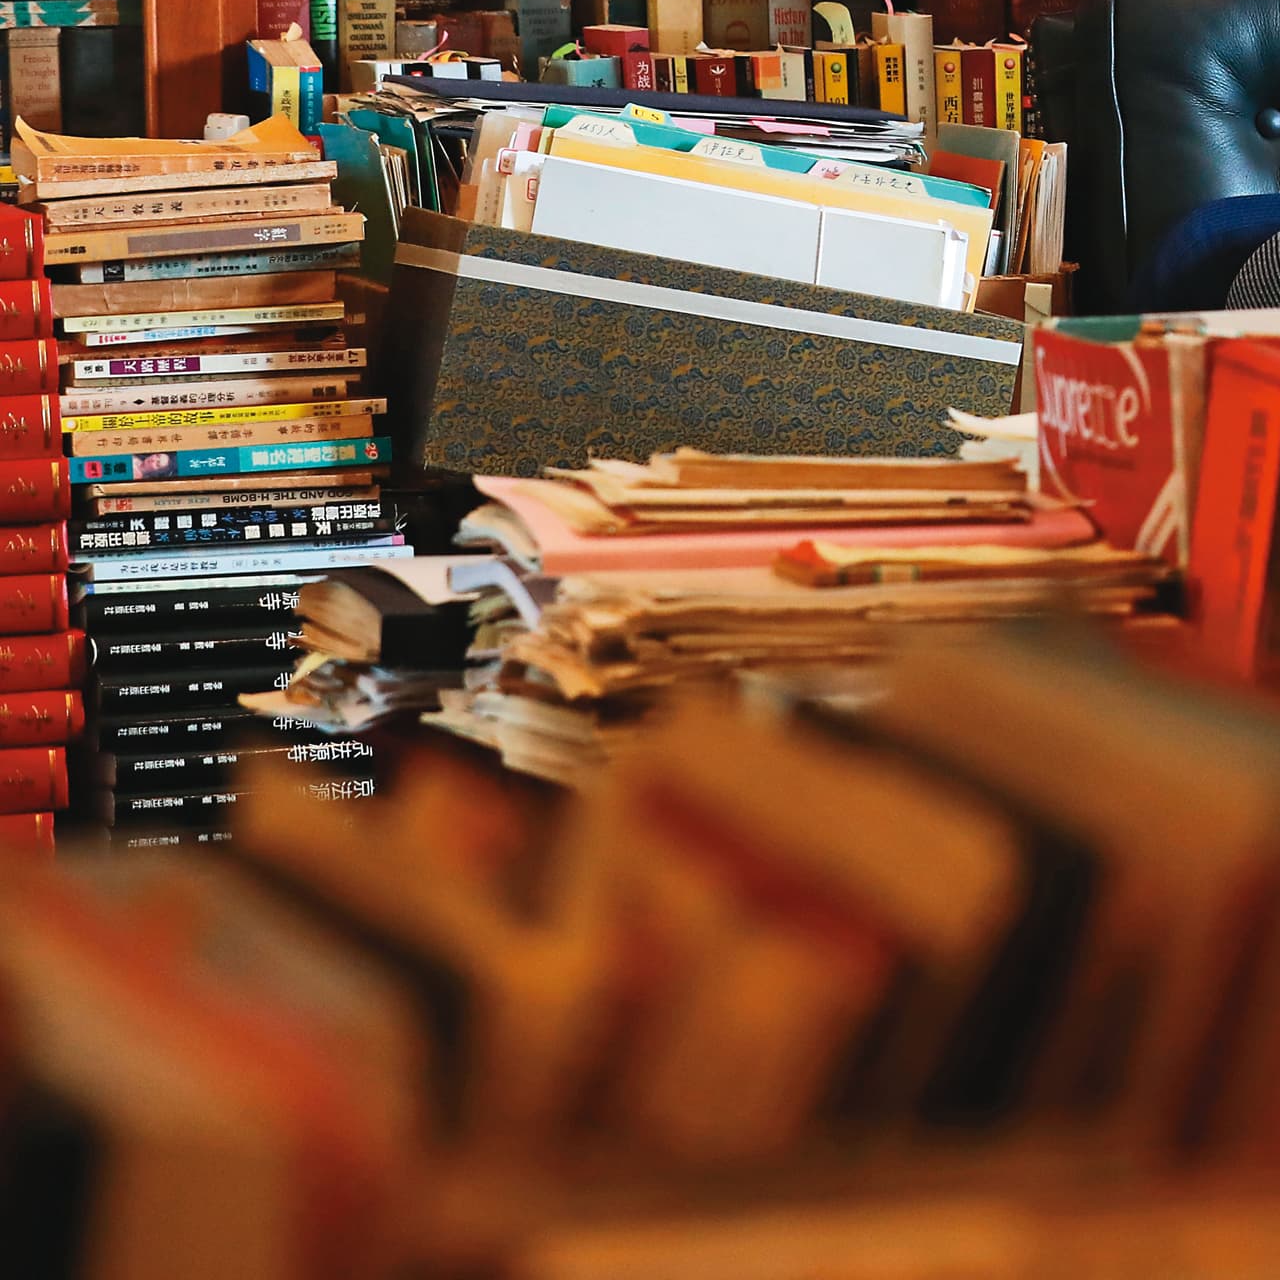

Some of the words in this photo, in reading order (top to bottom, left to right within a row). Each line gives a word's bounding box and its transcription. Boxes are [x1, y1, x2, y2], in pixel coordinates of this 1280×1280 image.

[361, 2, 377, 10] THE
[774, 7, 807, 25] History
[350, 33, 371, 41] GUIDE
[348, 43, 388, 52] SOCIALISM
[252, 227, 288, 242] 紅字
[124, 358, 197, 373] 天路歷程
[102, 409, 216, 430] 關於上帝的故事
[222, 493, 270, 503] H-BOMB
[273, 492, 298, 501] THE
[300, 491, 325, 500] AND
[120, 561, 219, 574] 为什么我不是基督教徒
[104, 604, 156, 616] 李敖出版社
[110, 643, 162, 655] 李敖出版社
[119, 684, 171, 697] 李敖出版社
[117, 724, 170, 737] 李敖出版社
[134, 758, 186, 771] 李敖出版社
[132, 797, 184, 810] 李敖出版社
